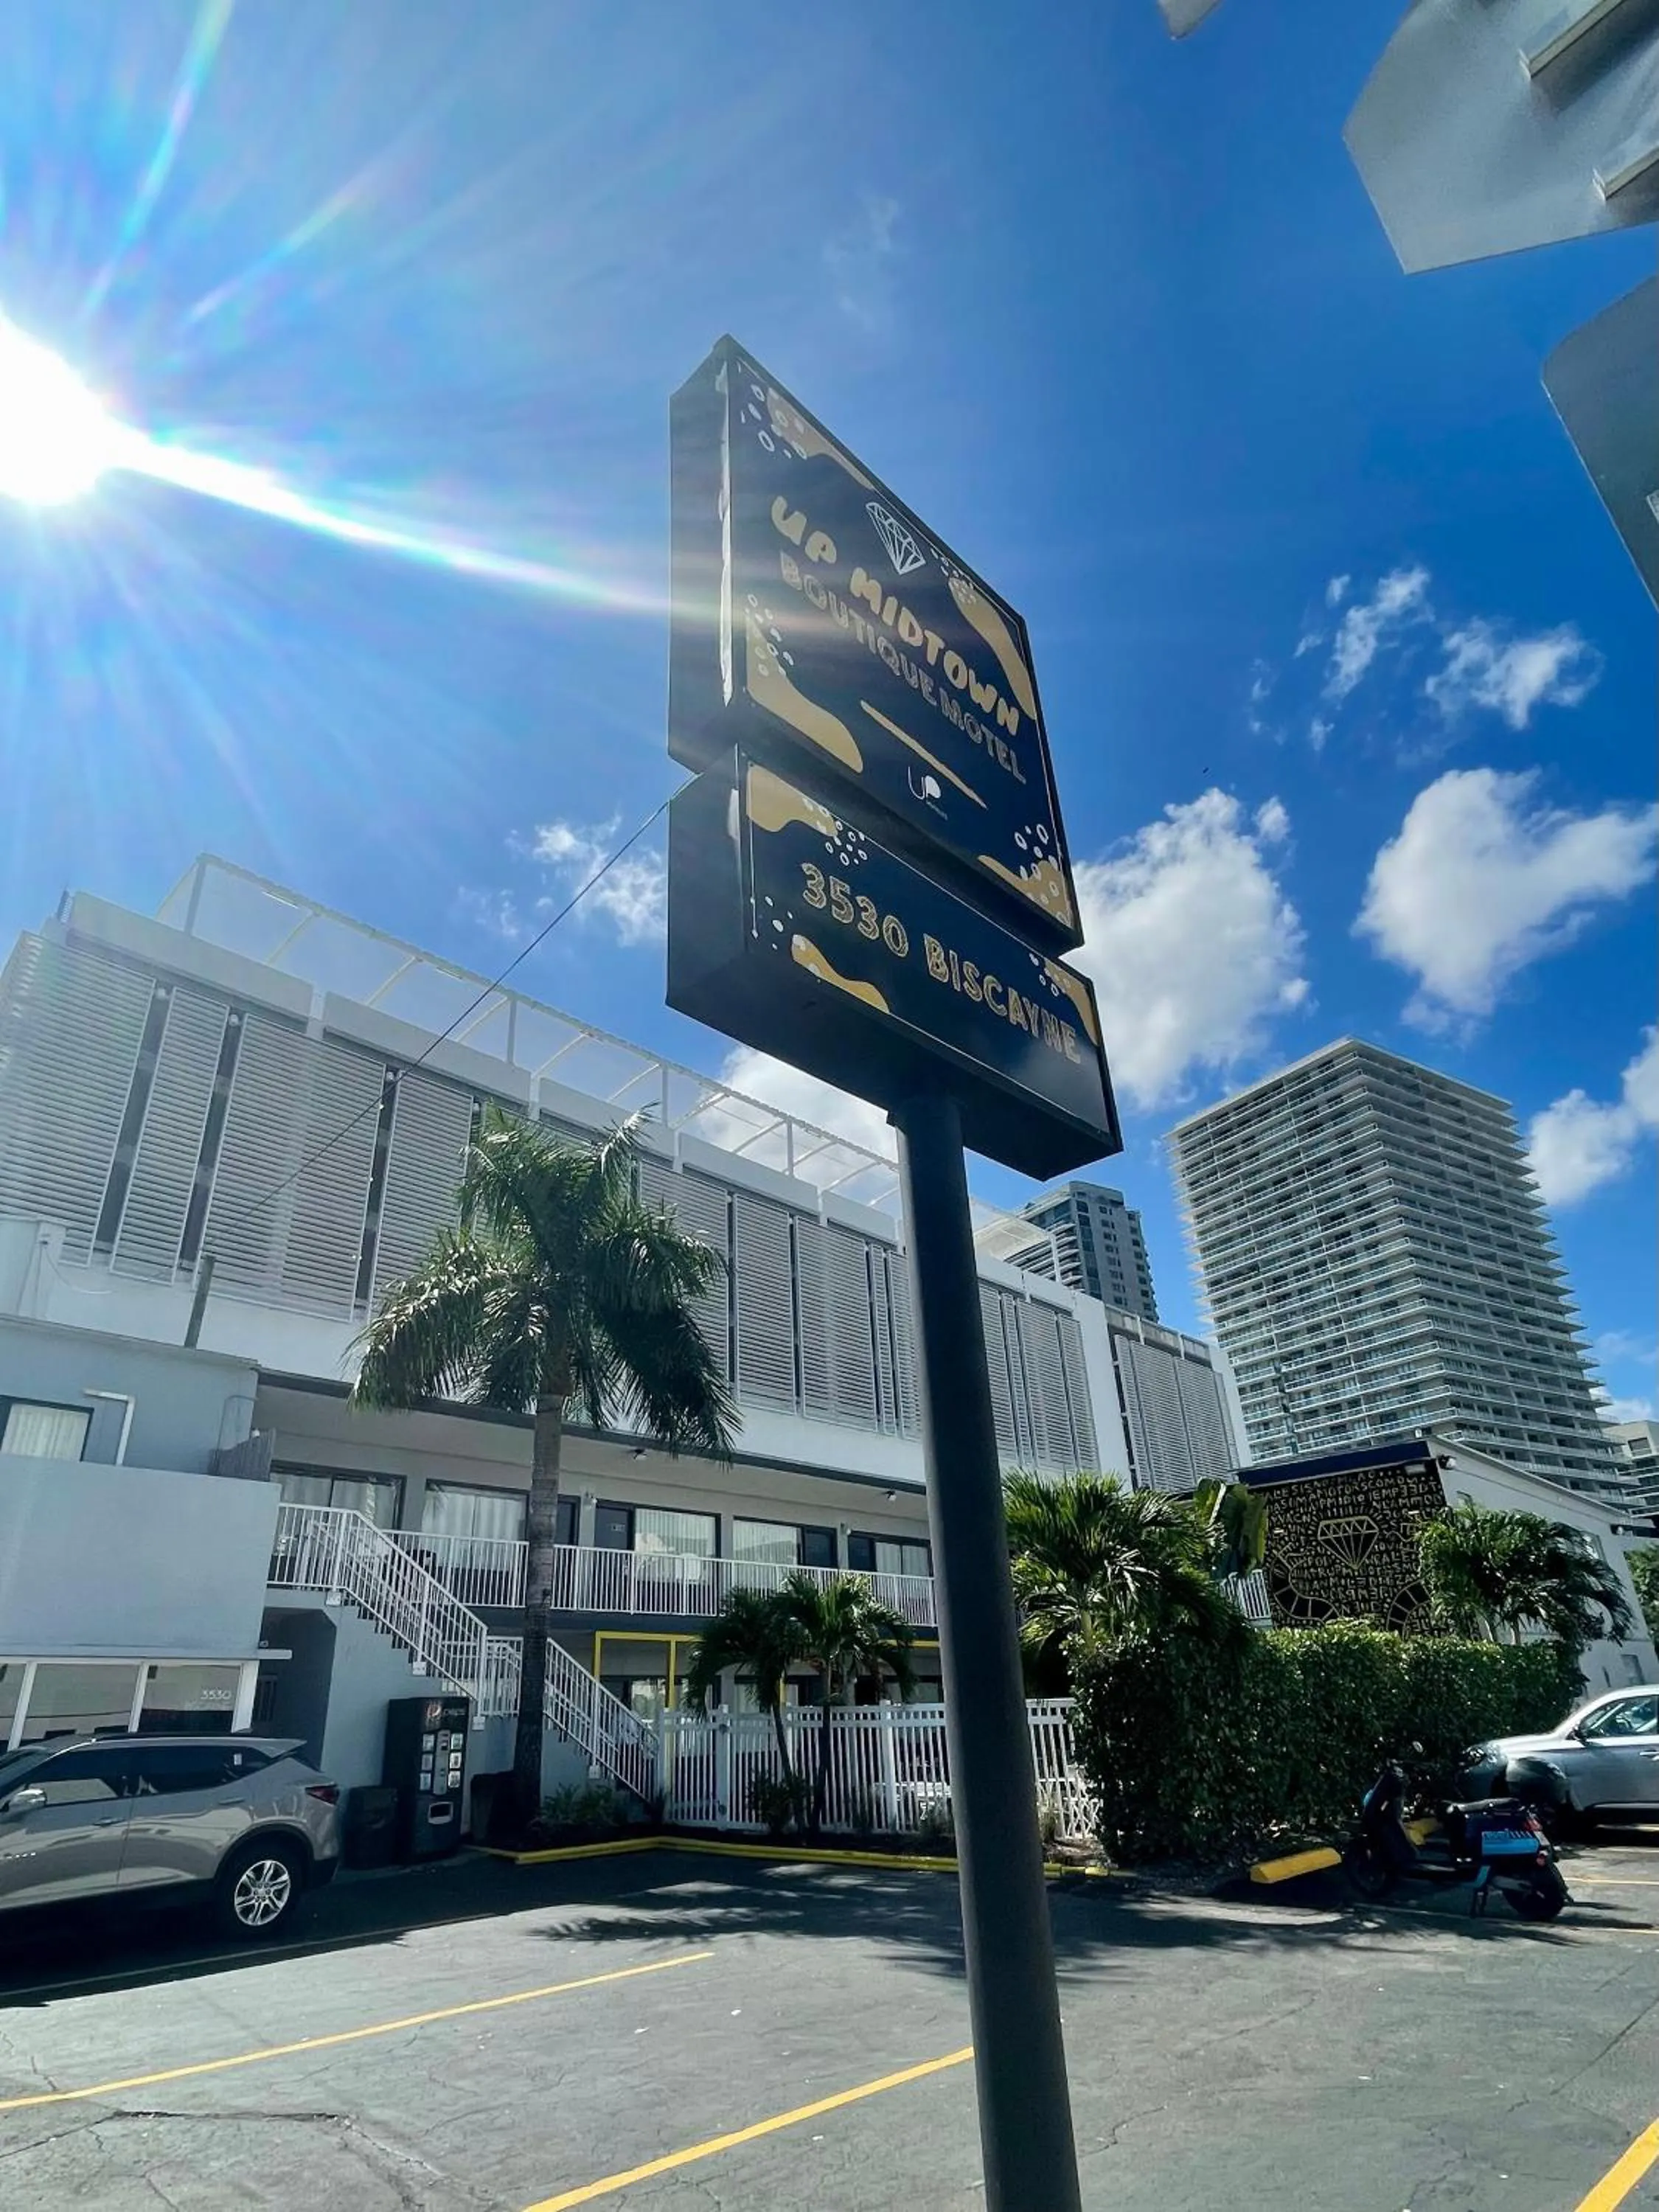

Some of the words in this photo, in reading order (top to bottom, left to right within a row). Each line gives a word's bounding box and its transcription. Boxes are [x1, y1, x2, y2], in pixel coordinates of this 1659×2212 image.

[771, 495, 837, 564] UP
[849, 567, 1019, 736] MIDTOWN
[779, 551, 937, 706] BOUTIQUE
[939, 688, 1026, 785] MOTEL
[800, 863, 909, 958] 3530
[922, 933, 1082, 1065] BISCAYNE
[200, 1688, 232, 1700] 3530
